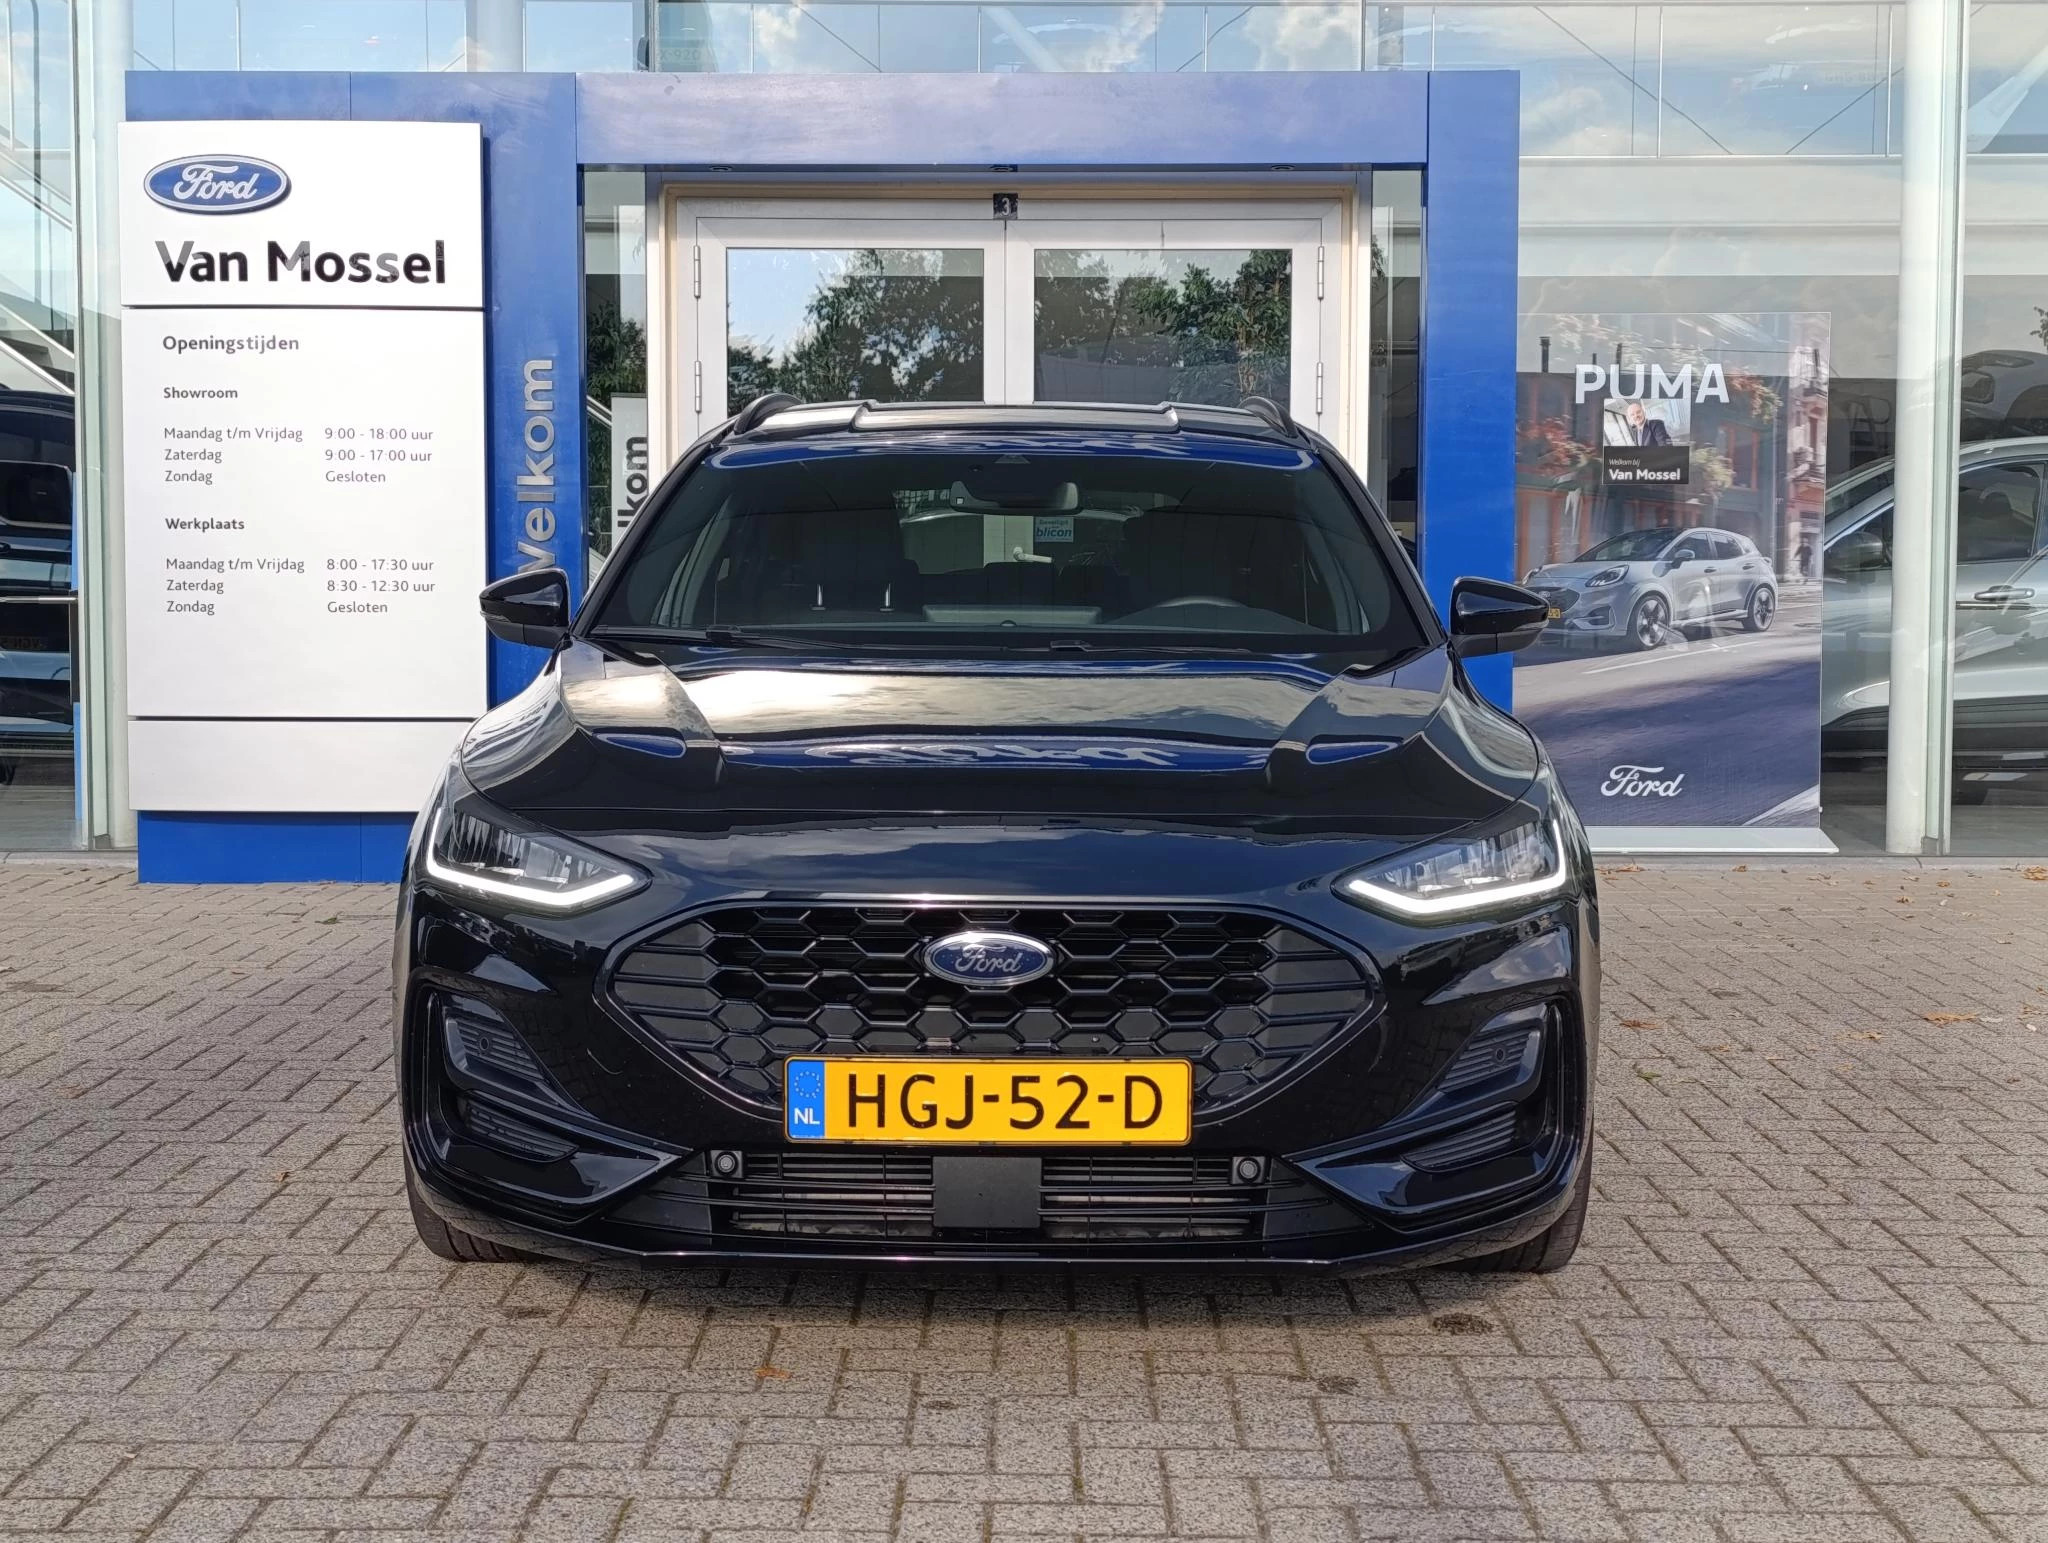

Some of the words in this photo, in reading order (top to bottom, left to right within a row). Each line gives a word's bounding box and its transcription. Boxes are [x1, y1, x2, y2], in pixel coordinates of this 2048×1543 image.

[173, 164, 260, 200] Ford
[1001, 197, 1010, 216] 3
[156, 240, 249, 283] Van
[267, 239, 446, 284] Mossel
[162, 335, 300, 354] Openingstijden
[1575, 363, 1730, 404] PUMA
[163, 386, 238, 399] Showroom
[164, 427, 223, 443] Maandag
[226, 427, 251, 440] t/m
[254, 427, 304, 443] Vrijdag
[324, 428, 356, 440] 9:00
[369, 428, 407, 441] 18:00
[411, 431, 434, 441] uur
[164, 448, 223, 464] Zaterdag
[324, 449, 356, 461] 9:00
[370, 449, 406, 462] 17:00
[410, 453, 433, 462] uur
[164, 469, 213, 486] Zondag
[325, 470, 386, 483] Gesloten
[1608, 469, 1633, 480] Van
[1636, 468, 1681, 480] Mossel
[164, 517, 245, 533] Werkplaats
[1036, 527, 1072, 537] blicon
[166, 557, 225, 574] Maandag
[228, 557, 253, 570] t/m
[256, 557, 305, 574] Vrijdag
[326, 559, 358, 571] 8:00
[371, 559, 408, 571] 17:30
[411, 562, 434, 571] uur
[166, 578, 225, 595] Zaterdag
[327, 580, 358, 592] 8:30
[371, 580, 409, 592] 12:30
[413, 583, 436, 592] uur
[166, 600, 215, 616] Zondag
[327, 600, 388, 613] Gesloten
[1600, 764, 1686, 797] Ford
[955, 943, 1023, 972] Ford
[848, 1073, 1163, 1130] HGJ-52-D
[794, 1107, 821, 1125] NL
